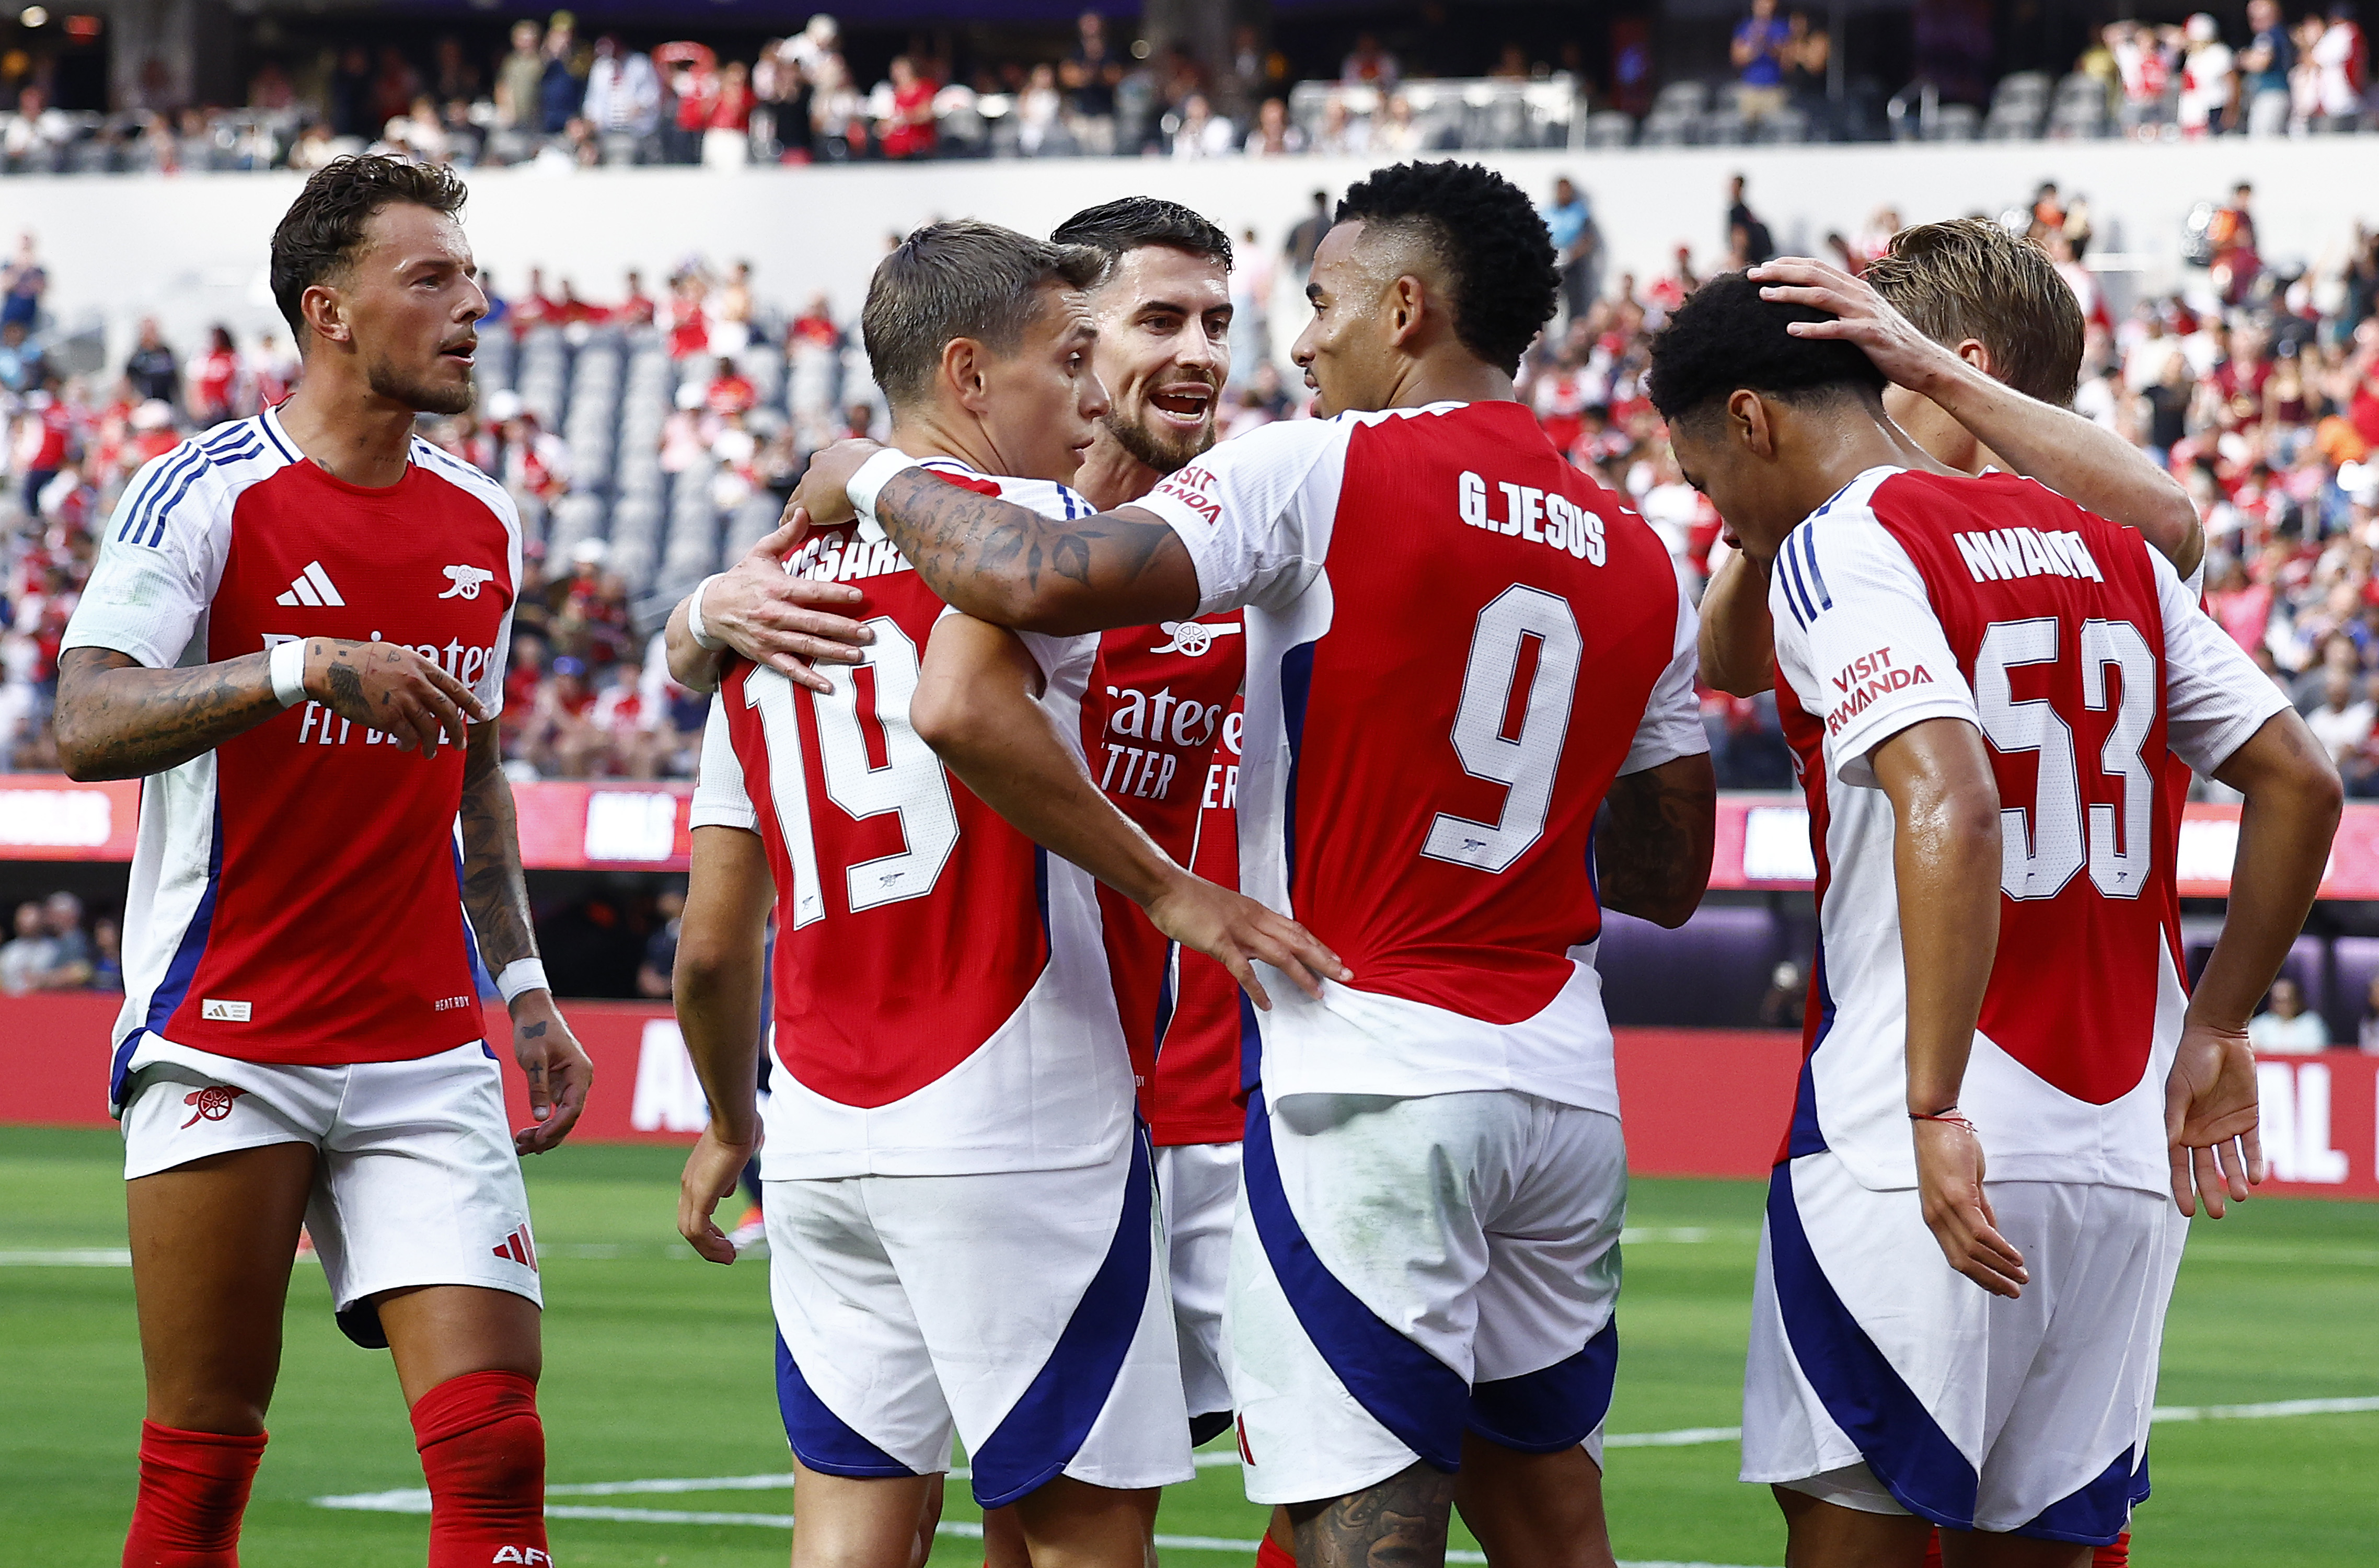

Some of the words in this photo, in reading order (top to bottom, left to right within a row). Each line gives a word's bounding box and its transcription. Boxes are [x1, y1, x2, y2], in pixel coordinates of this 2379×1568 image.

[1174, 466, 1217, 491] ISIT
[1459, 470, 1607, 567] G.JESUS
[1826, 664, 1934, 737] RWANDA
[1831, 646, 1891, 693] VISIT
[1419, 582, 1584, 874] 9
[1973, 616, 2156, 902] 53
[743, 615, 961, 931] 19
[1100, 742, 1177, 800] TTER
